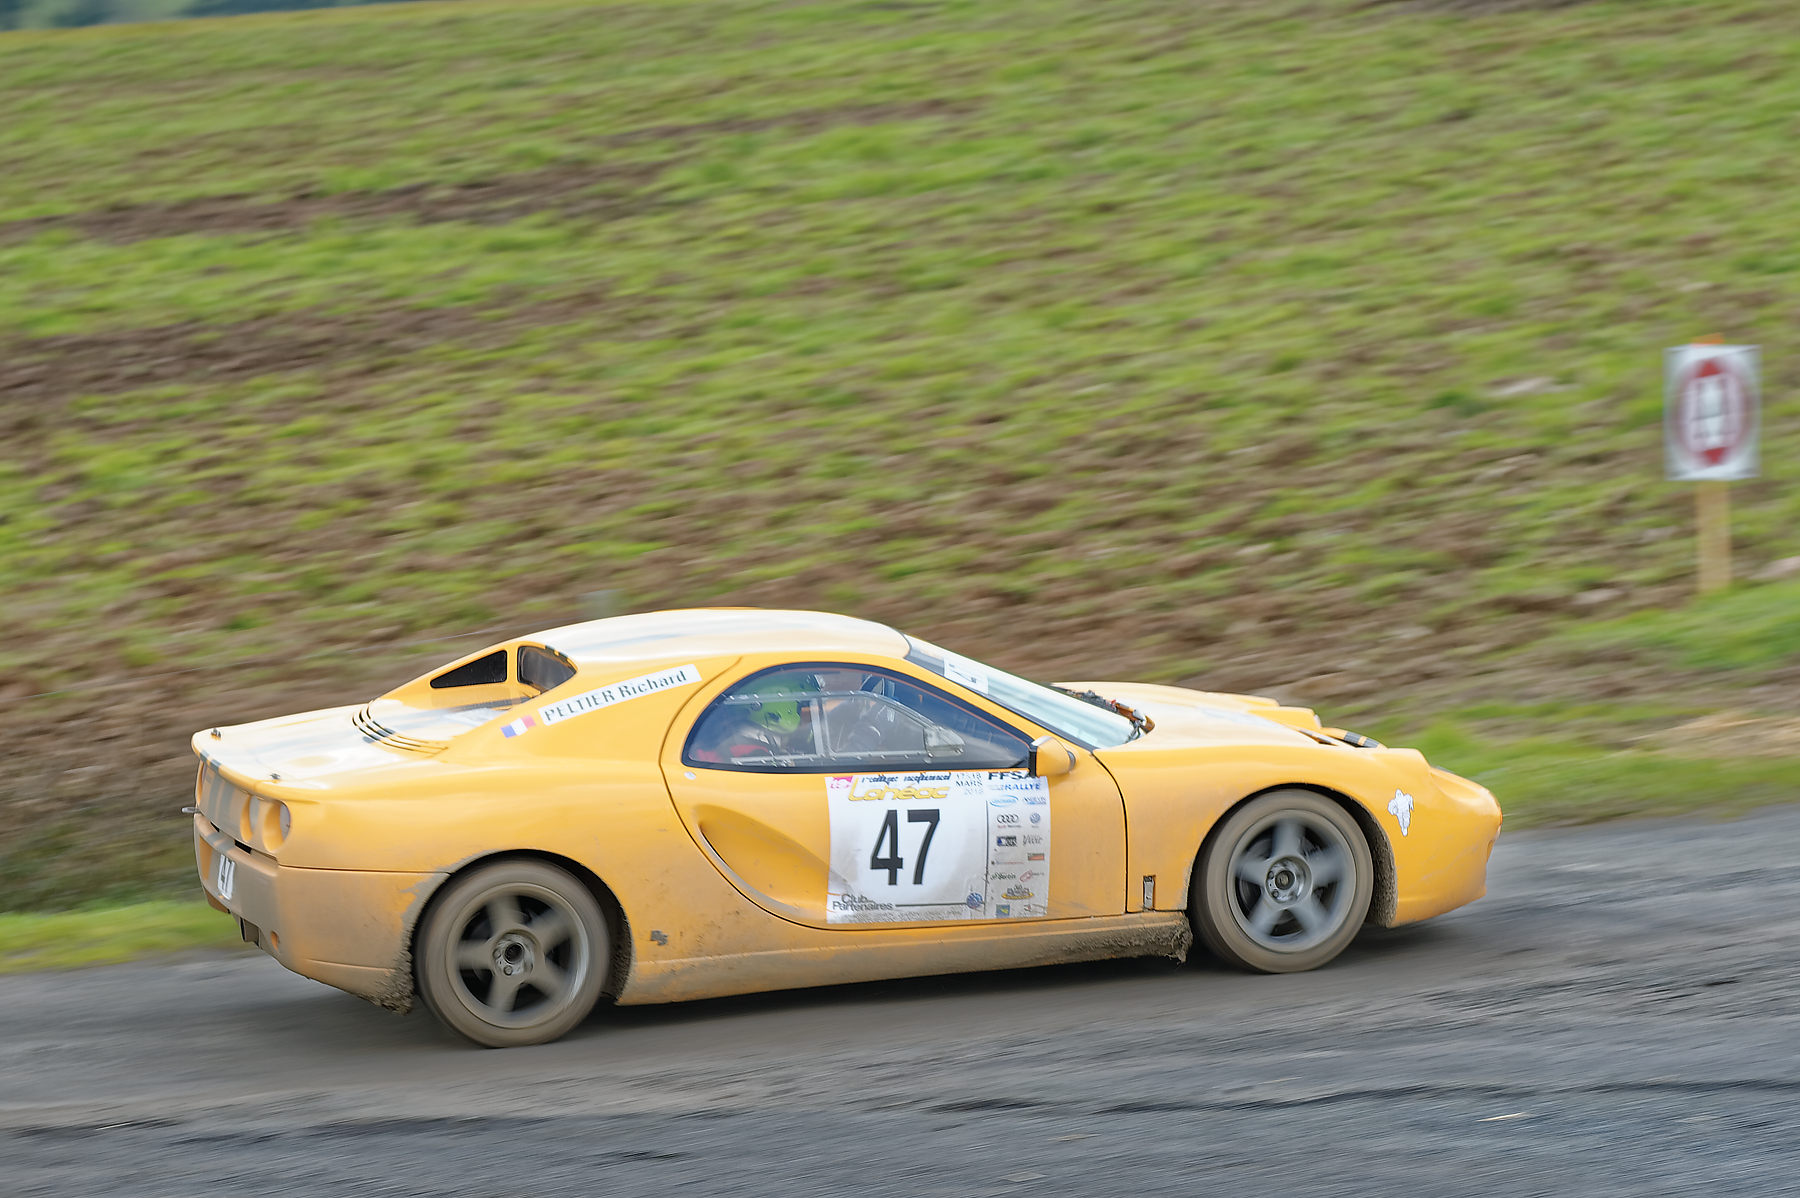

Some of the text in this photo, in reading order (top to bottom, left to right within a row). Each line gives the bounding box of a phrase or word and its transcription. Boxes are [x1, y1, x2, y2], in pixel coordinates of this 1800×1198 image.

[544, 670, 687, 721] PELTIER Richard
[870, 809, 941, 886] 47
[832, 900, 894, 911] Partenaires
[841, 893, 868, 904] Club
